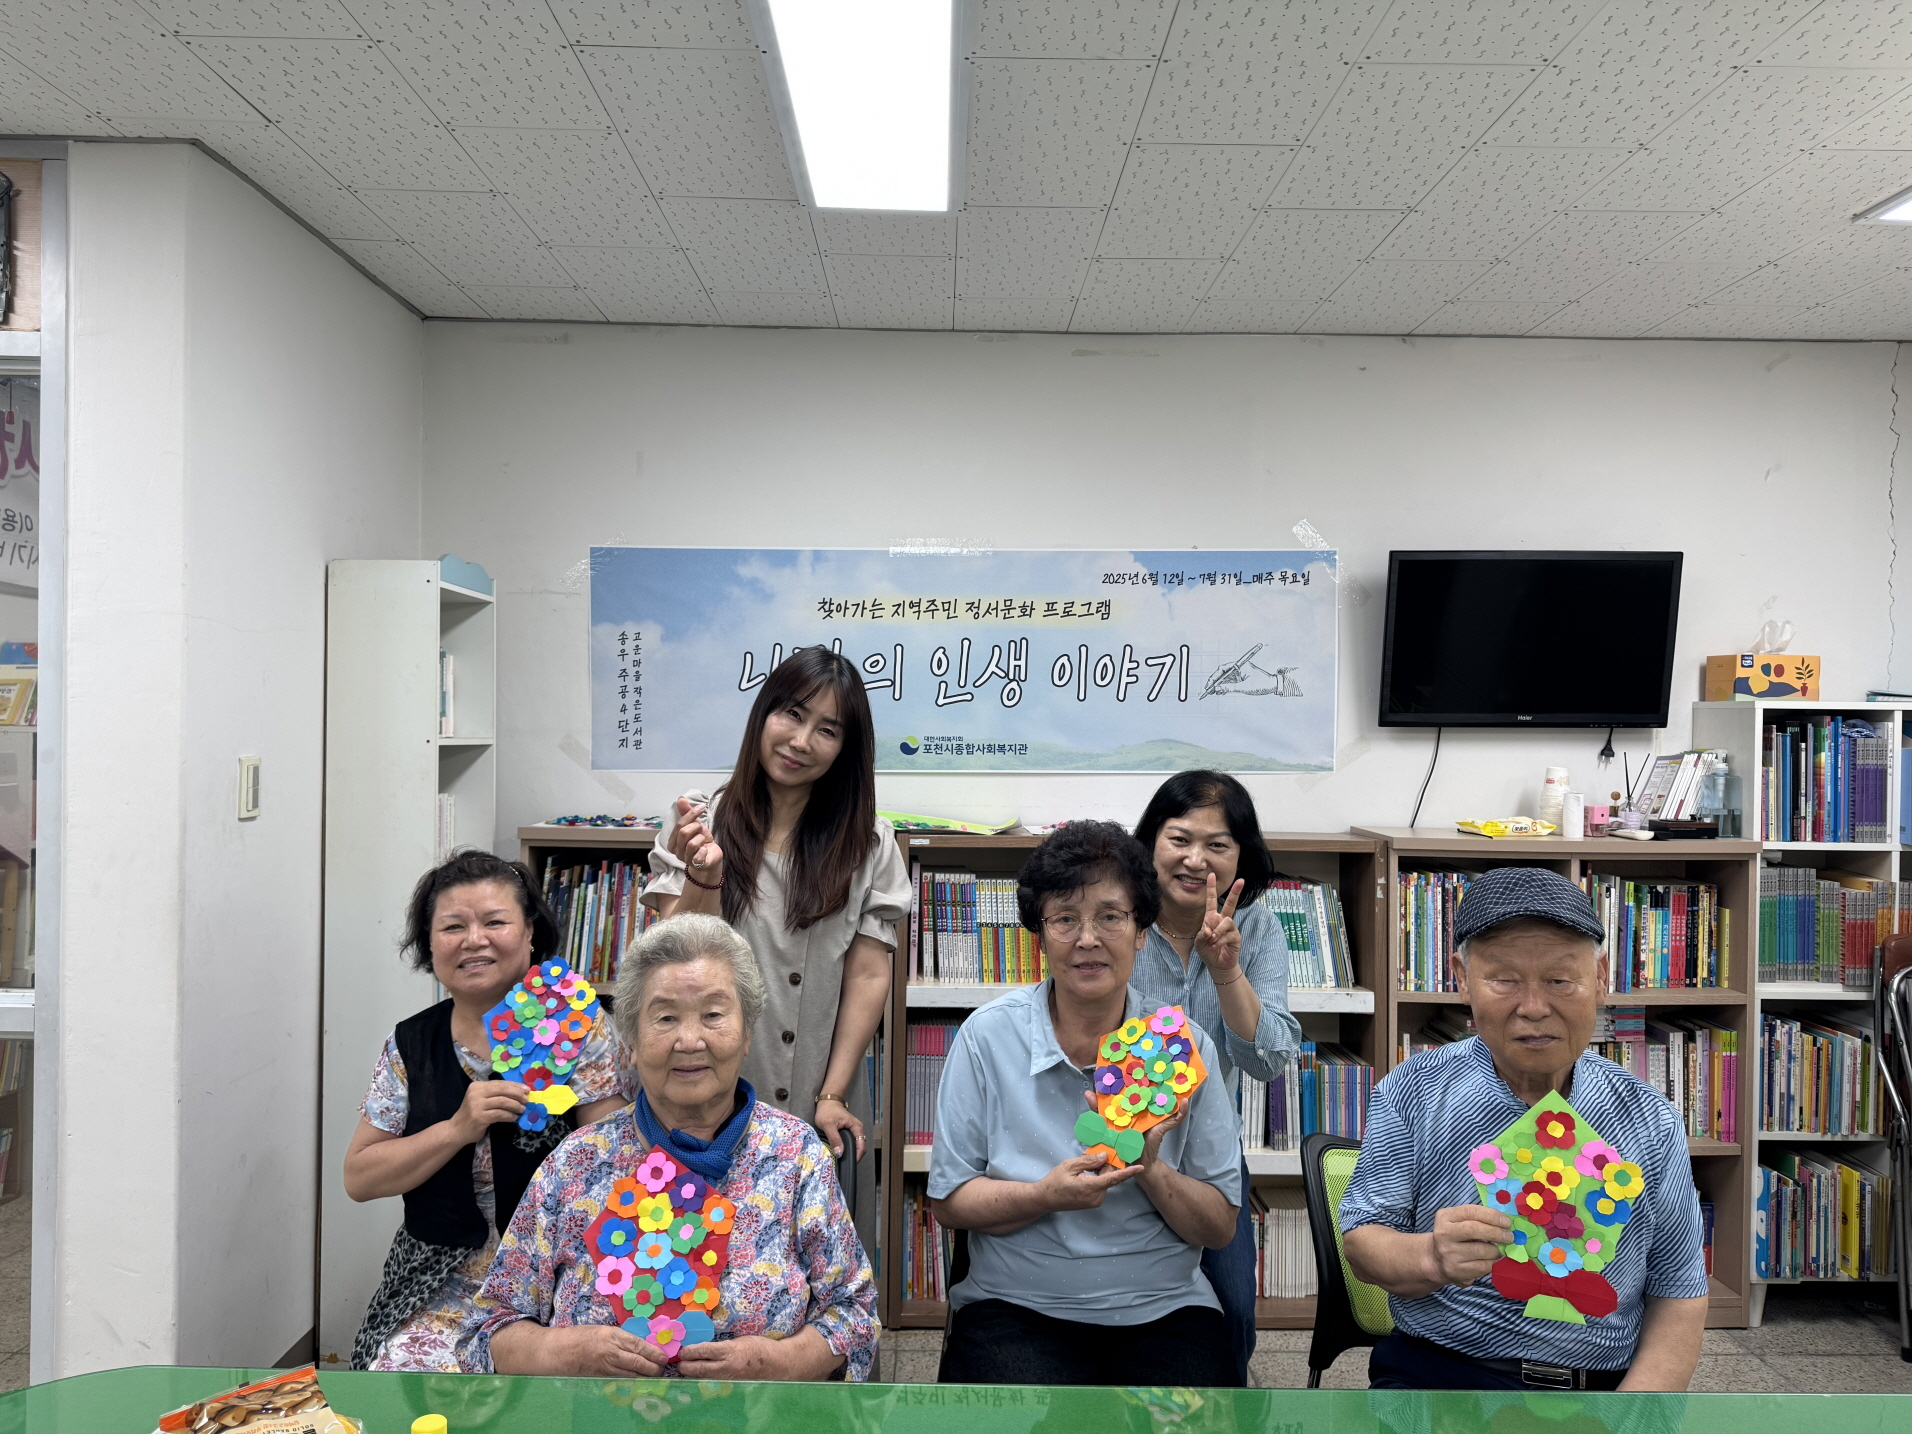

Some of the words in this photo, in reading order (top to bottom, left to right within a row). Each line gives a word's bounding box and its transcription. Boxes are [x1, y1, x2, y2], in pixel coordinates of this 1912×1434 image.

[1101, 571, 1140, 586] 2025년
[1141, 570, 1159, 586] 6월
[1163, 571, 1184, 586] 12일
[1199, 570, 1217, 586] 7월
[1278, 570, 1311, 586] 목요일
[817, 597, 886, 621] 찾아가는
[891, 597, 959, 621] 지역주민
[965, 598, 1036, 621] 정서문화
[1042, 598, 1112, 621] 프로그램
[738, 638, 904, 702] 나의
[929, 631, 1029, 708] 인생
[1050, 643, 1190, 703] 이야기
[617, 630, 630, 749] 송우주공4단지
[922, 743, 1029, 756] 포천시종합사회복지관
